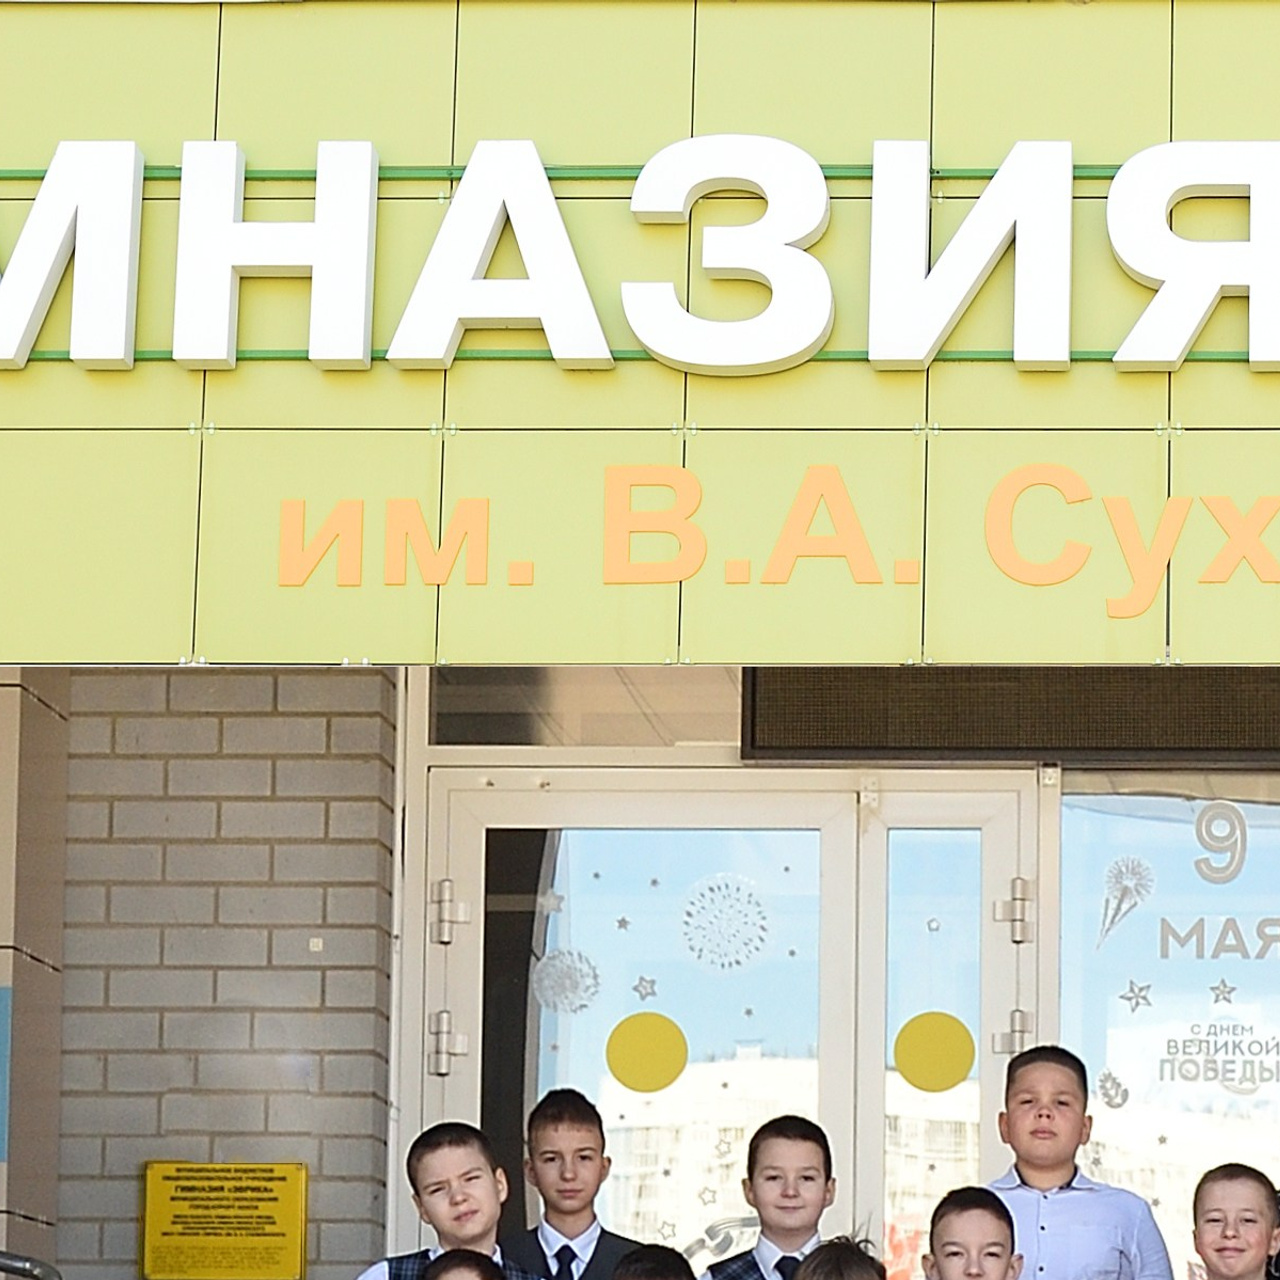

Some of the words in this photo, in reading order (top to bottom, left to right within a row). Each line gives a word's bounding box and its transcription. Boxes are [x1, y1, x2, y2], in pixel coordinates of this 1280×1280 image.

[278, 497, 534, 586] им.
[602, 463, 919, 585] В.А.
[1194, 800, 1247, 885] 9
[1166, 1036, 1280, 1056] ВЕЛИКОЙ
[1190, 1024, 1202, 1036] С
[1206, 1024, 1254, 1038] ДНЕМ
